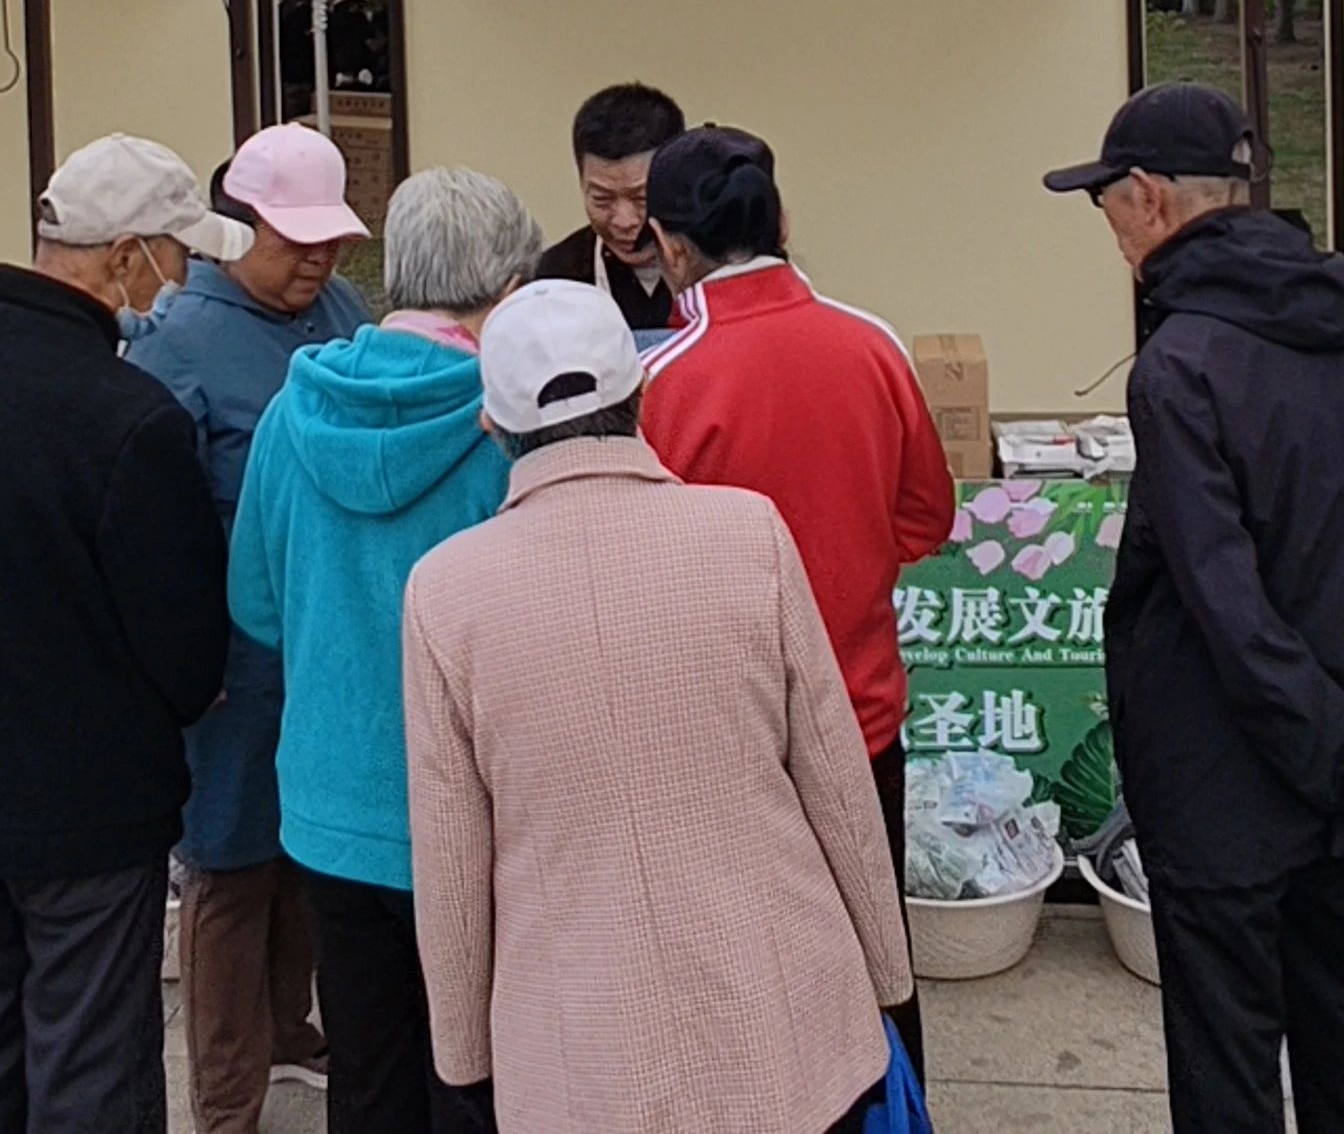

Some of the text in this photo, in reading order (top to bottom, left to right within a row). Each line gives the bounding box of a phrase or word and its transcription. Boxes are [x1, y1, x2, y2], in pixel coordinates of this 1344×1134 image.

[956, 648, 1014, 662] Culture
[1022, 648, 1052, 662] And
[900, 689, 1045, 753] 圣地
